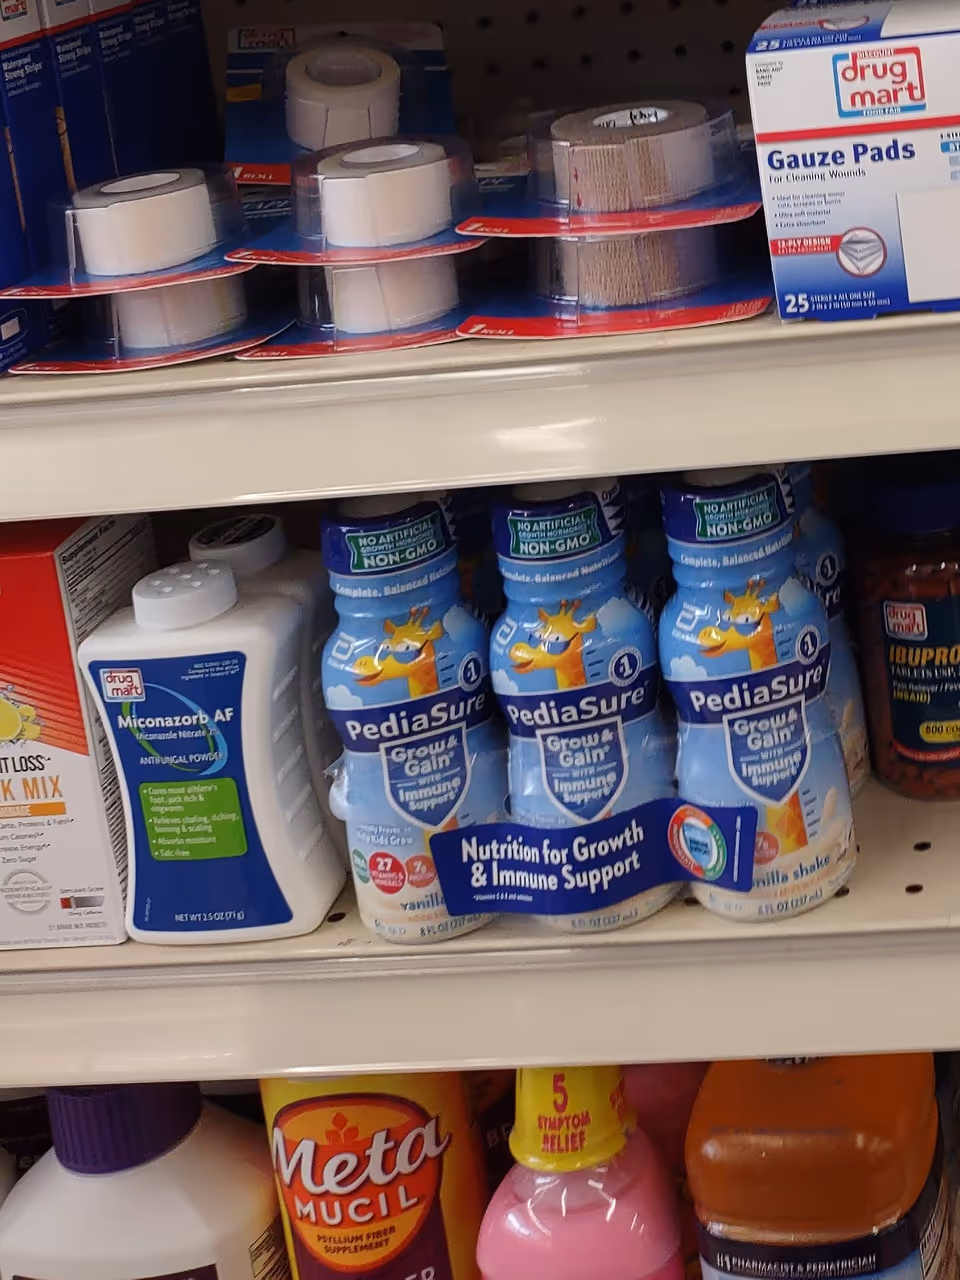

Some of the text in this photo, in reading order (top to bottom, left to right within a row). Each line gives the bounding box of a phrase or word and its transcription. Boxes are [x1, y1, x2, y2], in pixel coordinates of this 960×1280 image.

[841, 51, 907, 84] drug
[850, 80, 926, 108] mart
[767, 140, 915, 170] Gauze Pads
[785, 293, 809, 314] 25
[363, 539, 437, 569] NON-GMO
[104, 672, 142, 697] drug mart
[691, 664, 823, 712] PediaSure
[118, 708, 234, 729] Miconazorb AF
[346, 691, 485, 741] PediaSure
[507, 686, 645, 726] PediaSure
[461, 820, 644, 863] Nutrition for Growth
[471, 851, 640, 892] & Immune Support
[552, 1074, 569, 1113] 5
[537, 1112, 592, 1135] SYMPTOM
[273, 1112, 449, 1192] Meta
[540, 1130, 587, 1154] RELIEF
[294, 1185, 420, 1225] MUCIL
